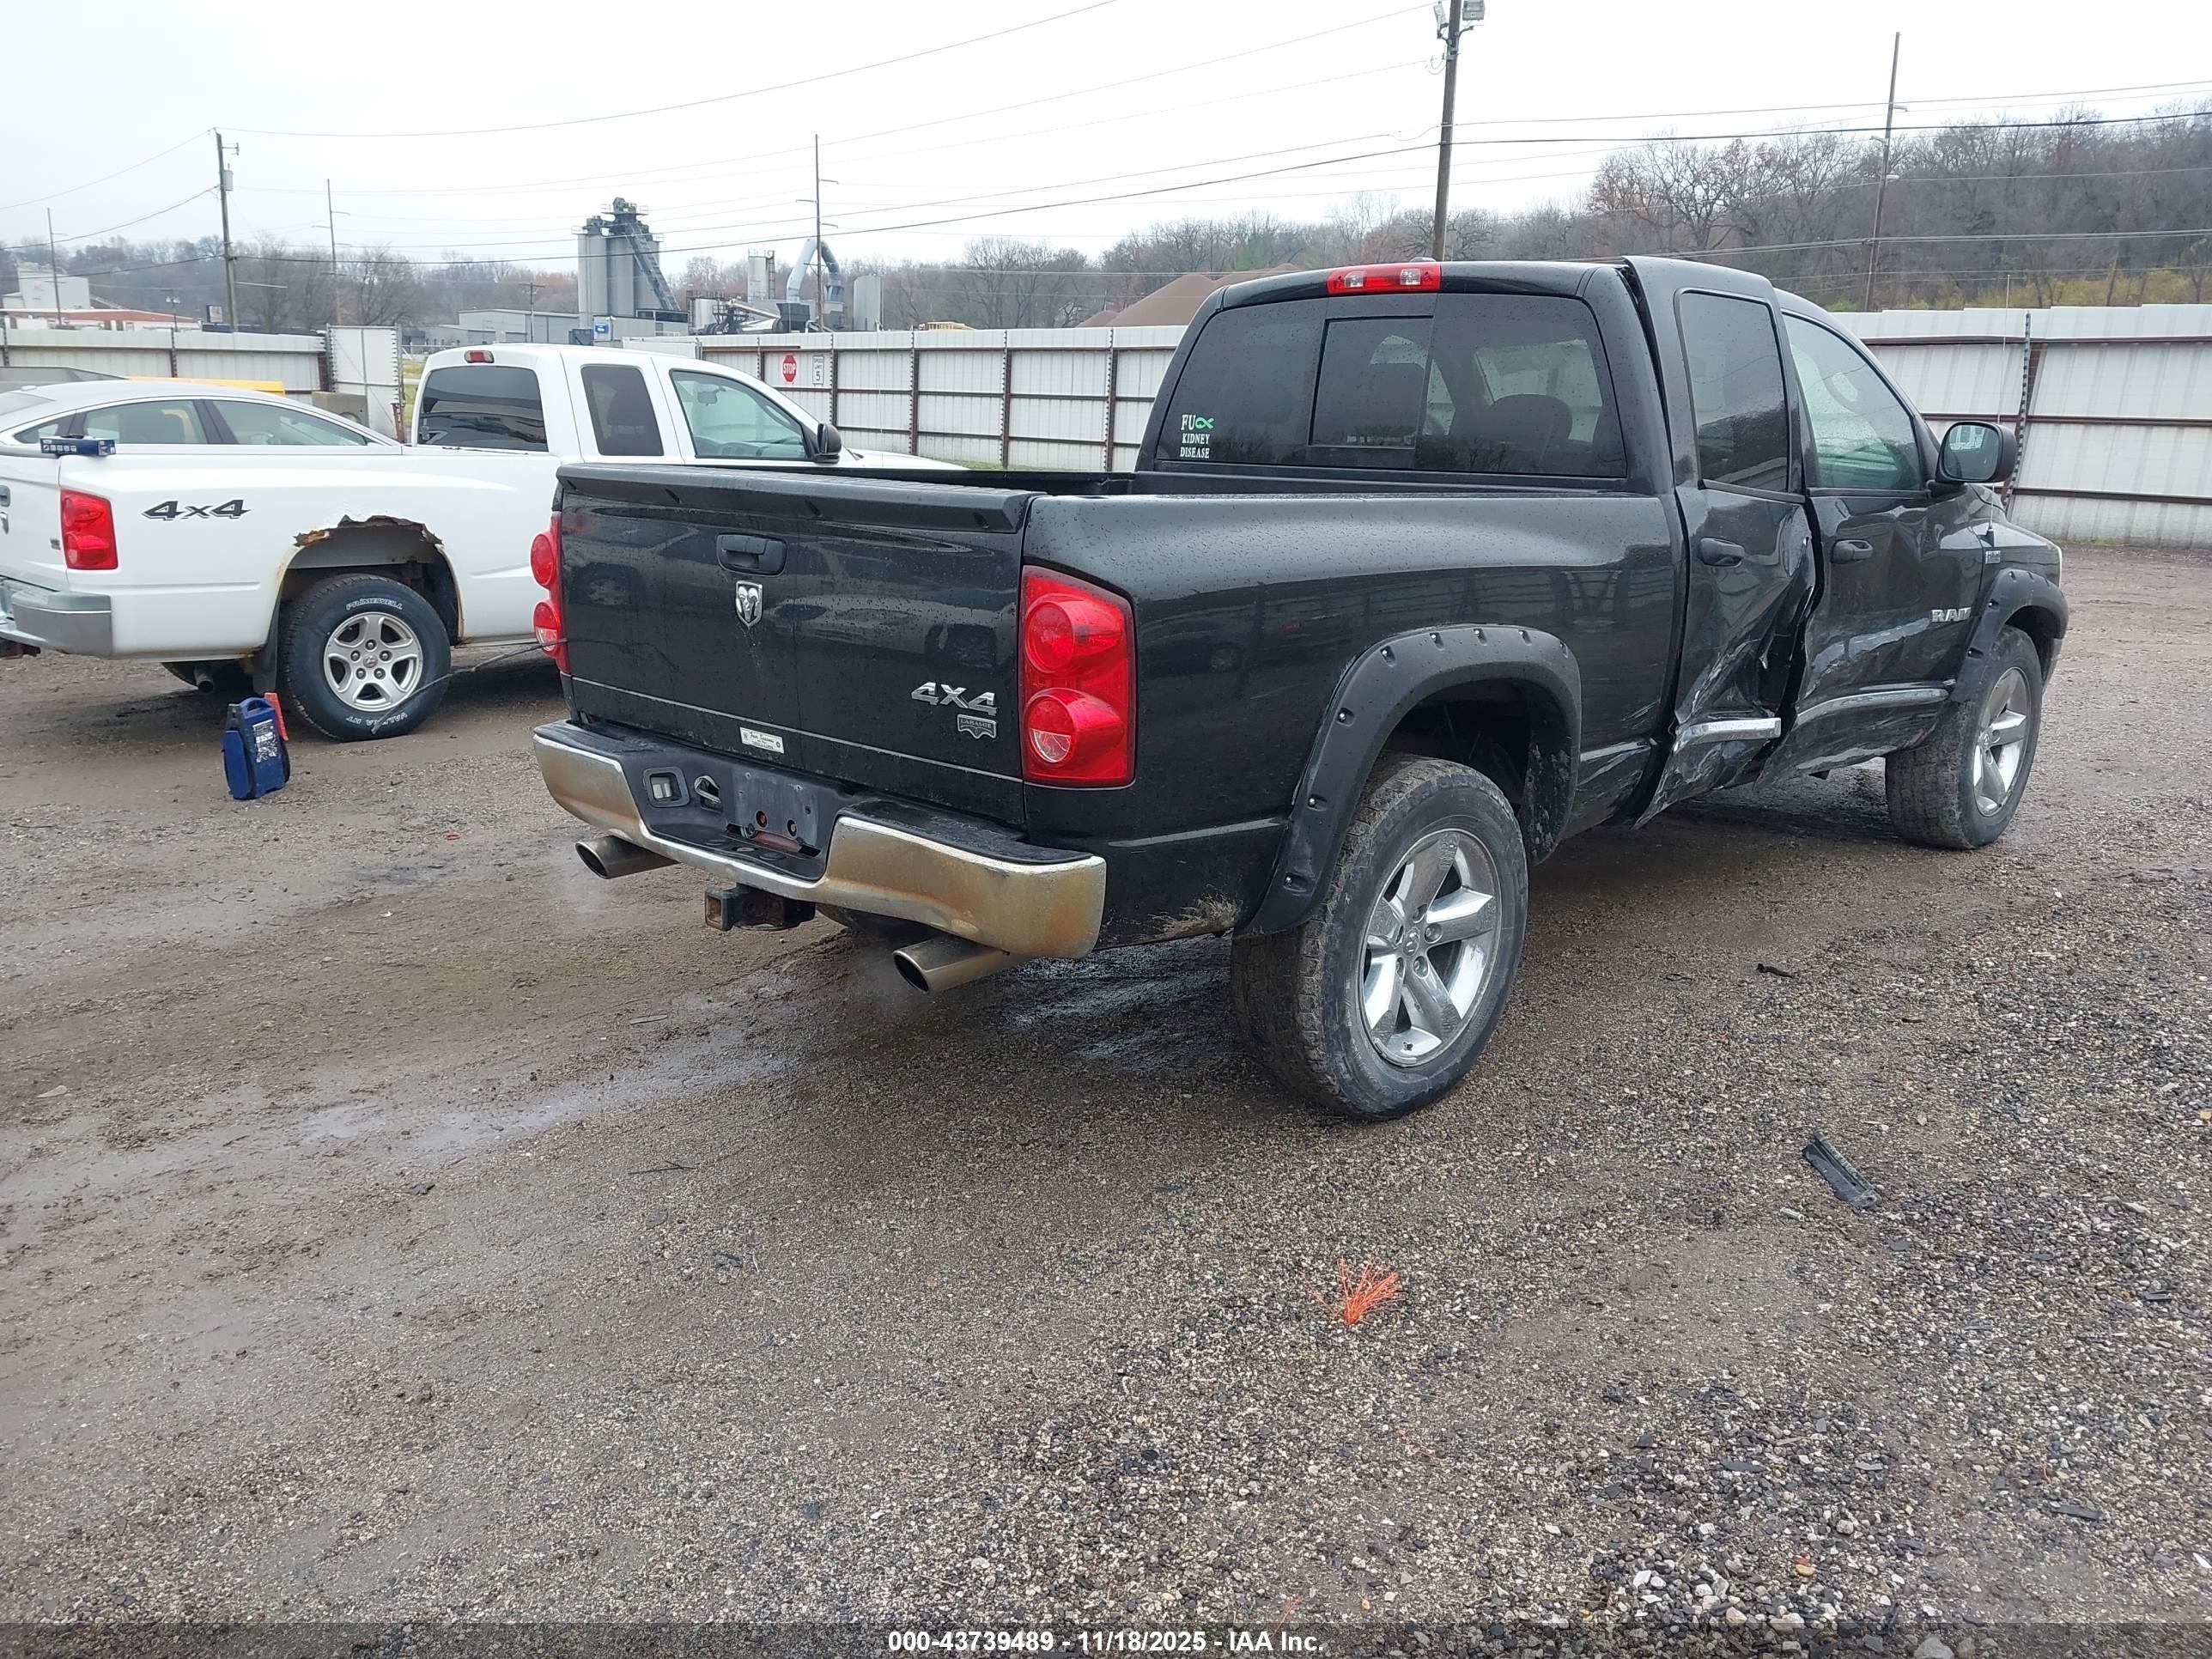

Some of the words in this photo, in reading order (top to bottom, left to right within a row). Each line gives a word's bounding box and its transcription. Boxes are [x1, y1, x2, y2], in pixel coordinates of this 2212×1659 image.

[783, 362, 796, 374] STOP
[816, 371, 821, 380] 5
[1182, 433, 1211, 445] KIDNEY
[1180, 447, 1210, 459] DISEASE
[1931, 606, 1972, 623] RAM
[960, 719, 993, 729] LARAMIE
